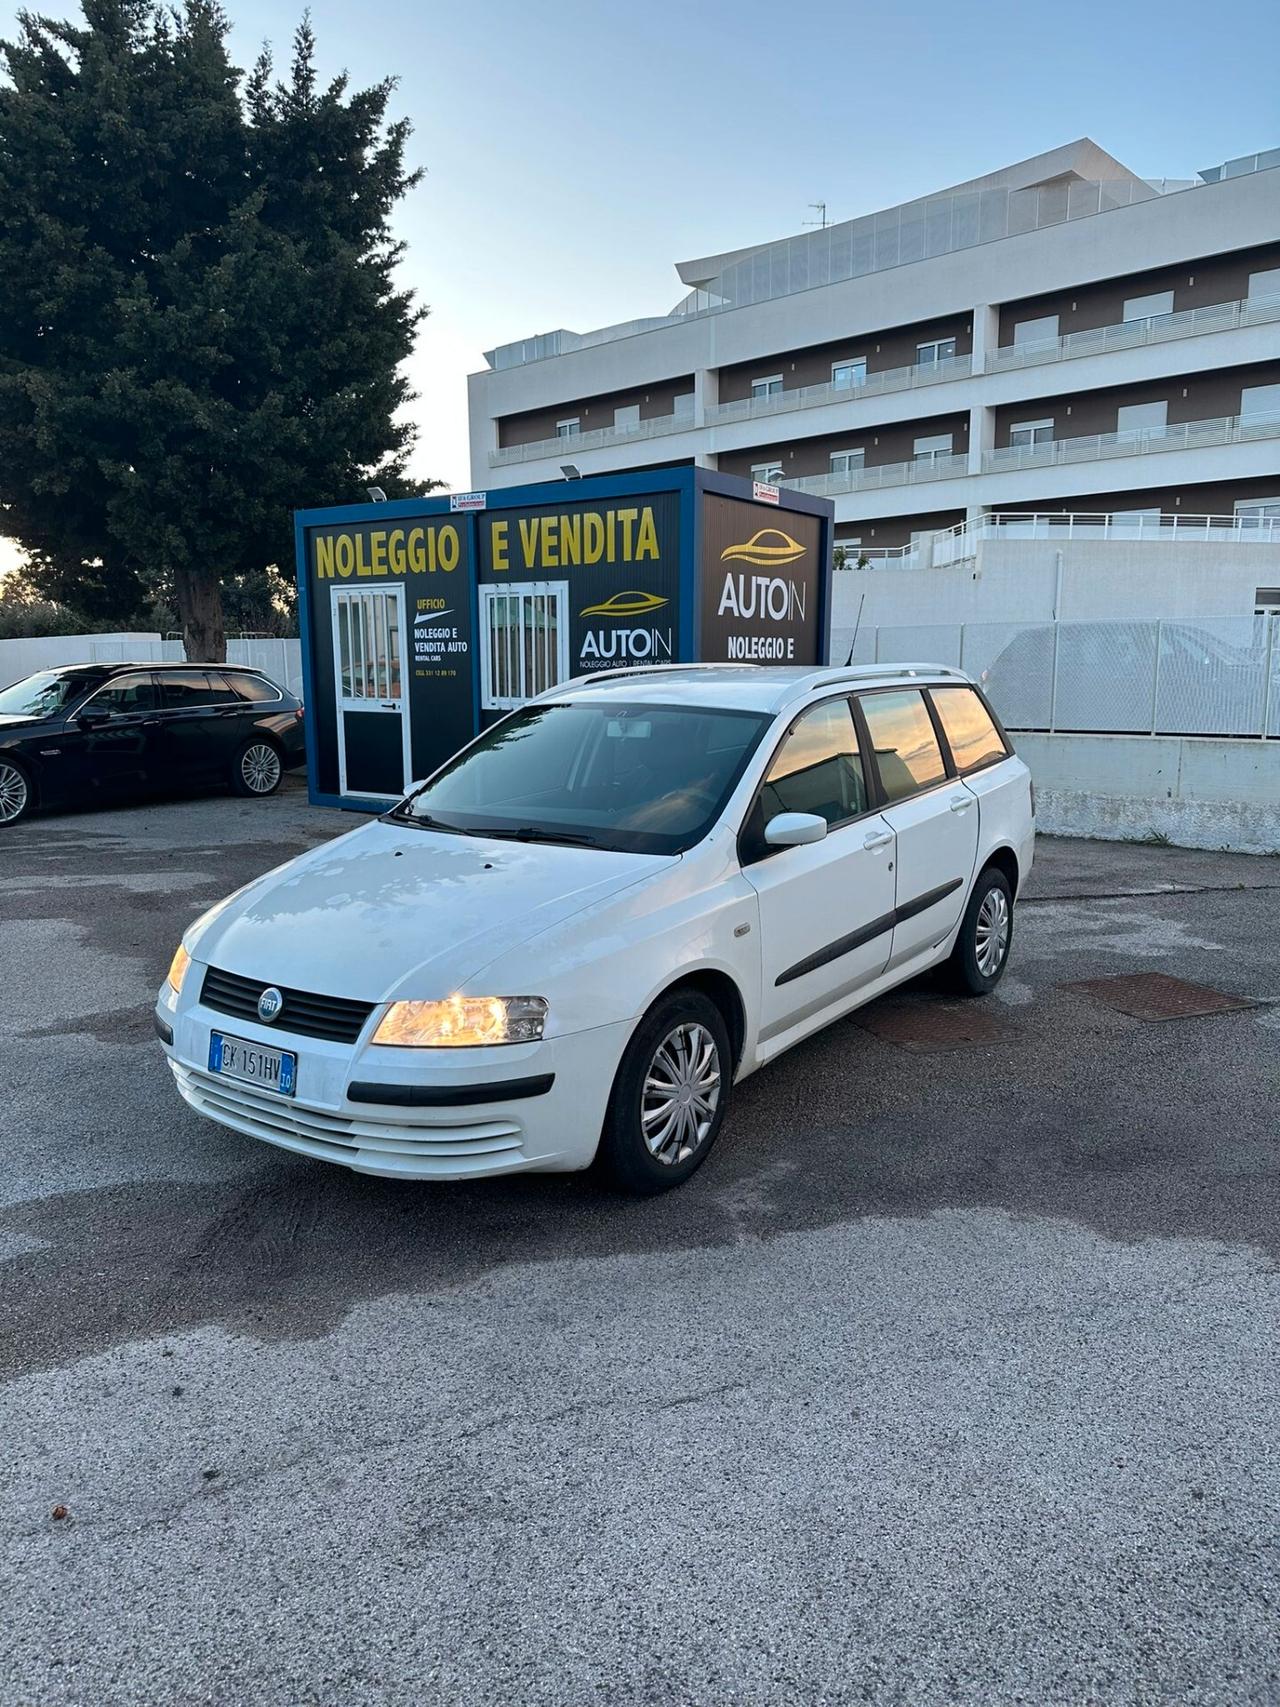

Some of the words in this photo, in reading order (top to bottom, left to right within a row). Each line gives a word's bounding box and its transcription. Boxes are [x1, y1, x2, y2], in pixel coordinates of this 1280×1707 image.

[316, 525, 460, 578] NOLEGGIO
[491, 521, 509, 570] E
[519, 507, 660, 568] VENDITA
[417, 599, 445, 609] UFFICIO
[718, 572, 806, 622] AUTOIN
[414, 628, 450, 639] NOLEGGIO
[452, 628, 458, 638] E
[580, 627, 672, 658] AUTOIN
[414, 642, 446, 653] VENDITA
[447, 641, 468, 653] AUTO
[727, 636, 784, 659] NOLEGGIO
[787, 638, 794, 659] E
[580, 660, 611, 668] NOLEGGIO
[261, 997, 277, 1011] FIAT
[223, 1044, 237, 1068] CK
[242, 1050, 280, 1080] 151HV
